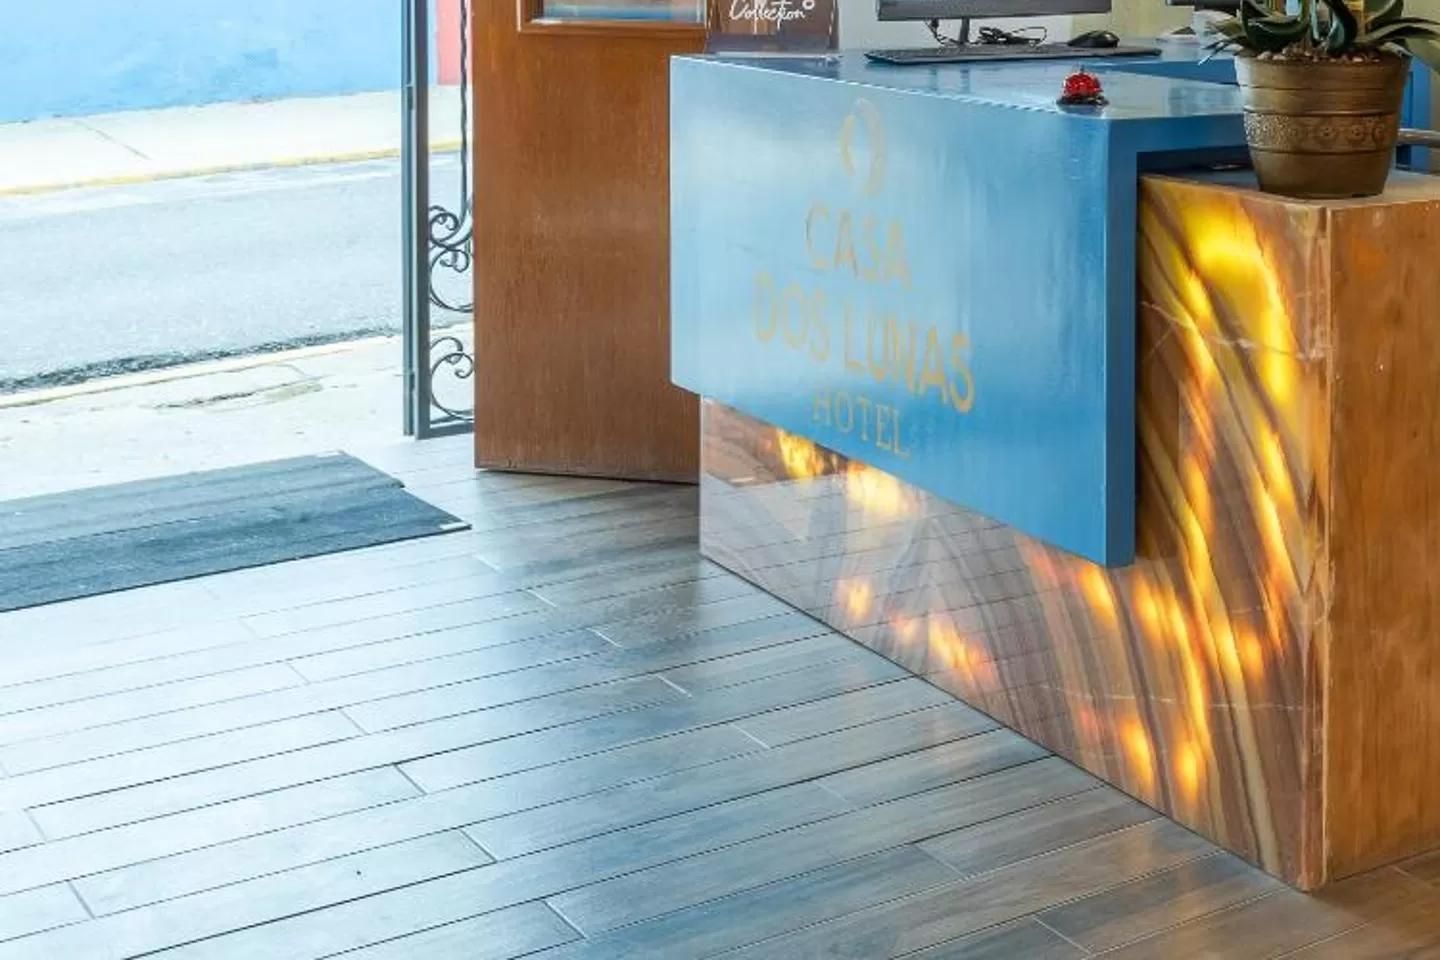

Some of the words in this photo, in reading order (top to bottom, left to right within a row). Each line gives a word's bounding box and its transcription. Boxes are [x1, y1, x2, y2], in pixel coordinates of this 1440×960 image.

[804, 201, 914, 291] CASA
[751, 270, 833, 362] DOS
[843, 300, 976, 414] LUNAS
[812, 388, 911, 458] HOTEL
